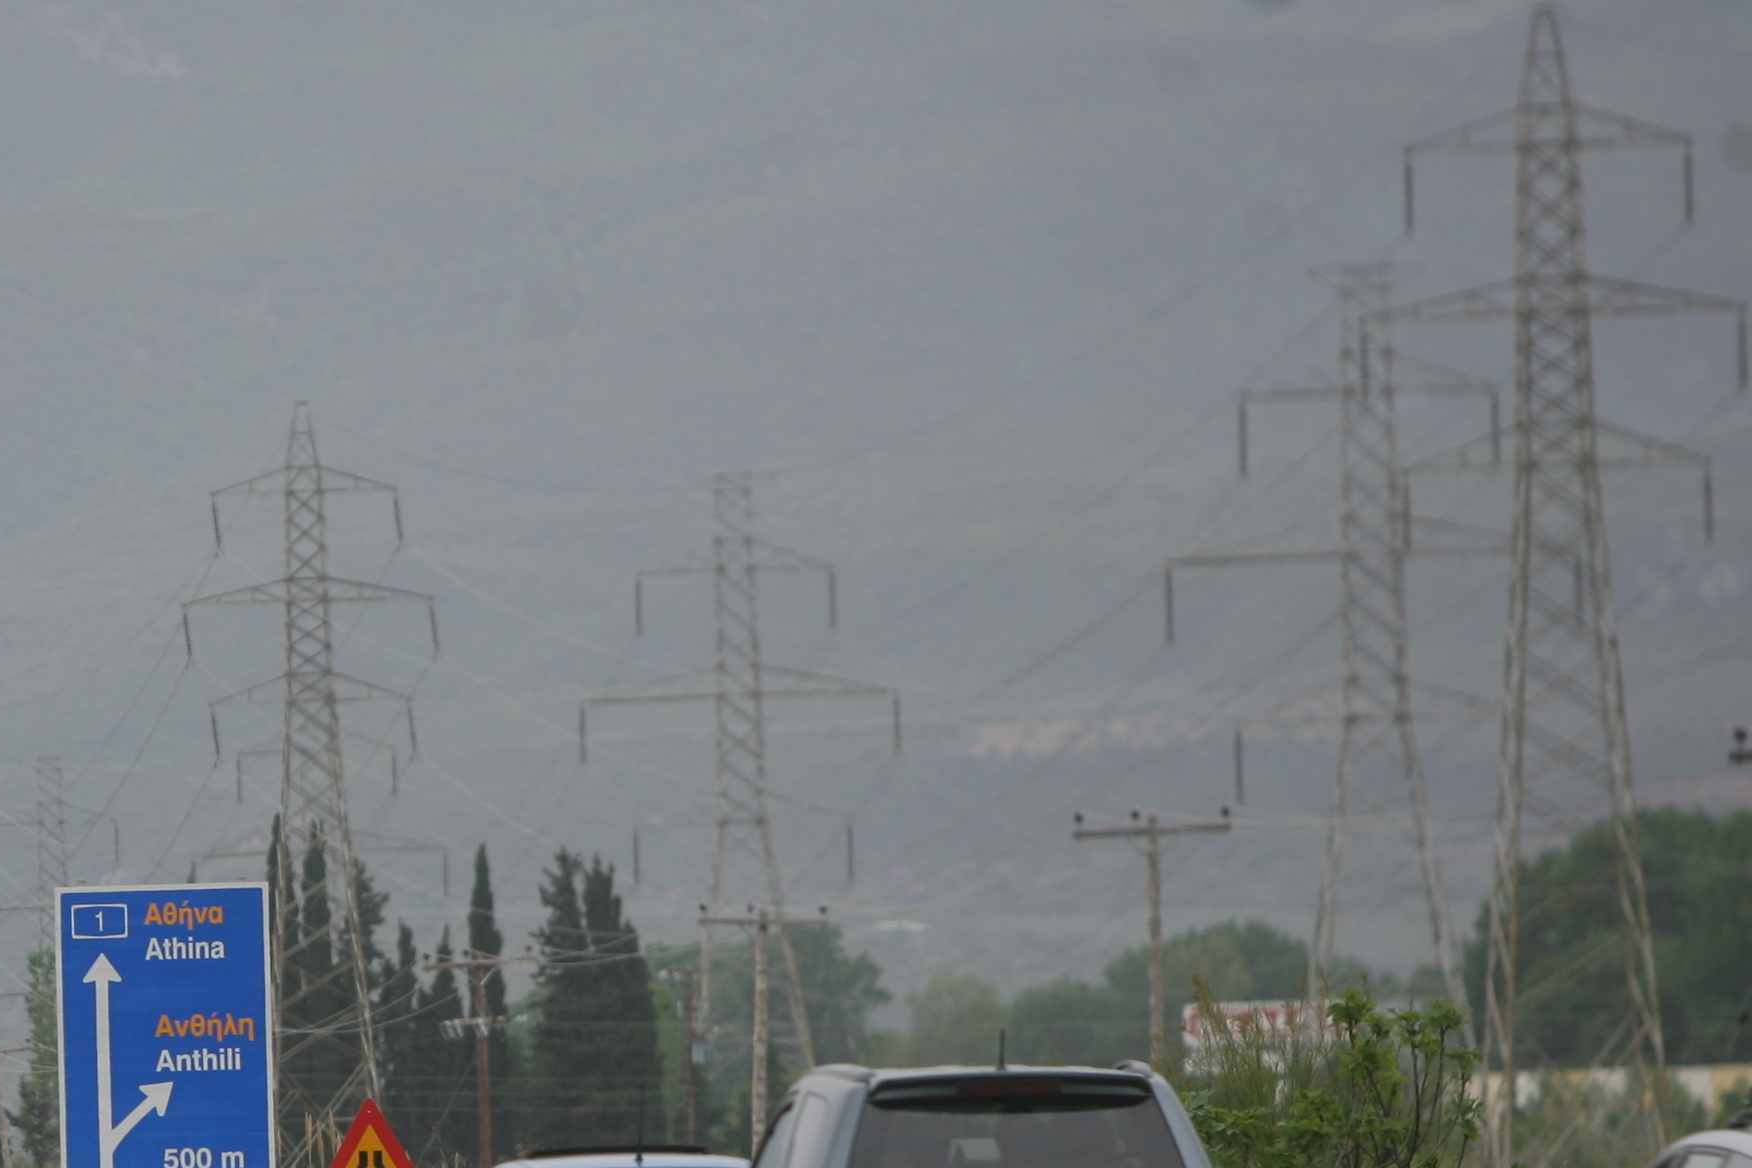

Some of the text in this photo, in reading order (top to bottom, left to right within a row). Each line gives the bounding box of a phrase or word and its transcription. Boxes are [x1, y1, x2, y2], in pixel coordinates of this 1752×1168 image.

[95, 911, 104, 932] 1
[144, 900, 224, 930] Αθήνα
[145, 936, 225, 961] Athina
[155, 1011, 256, 1041] Ανθήλη
[156, 1047, 241, 1072] Anthili
[221, 1151, 245, 1168] m
